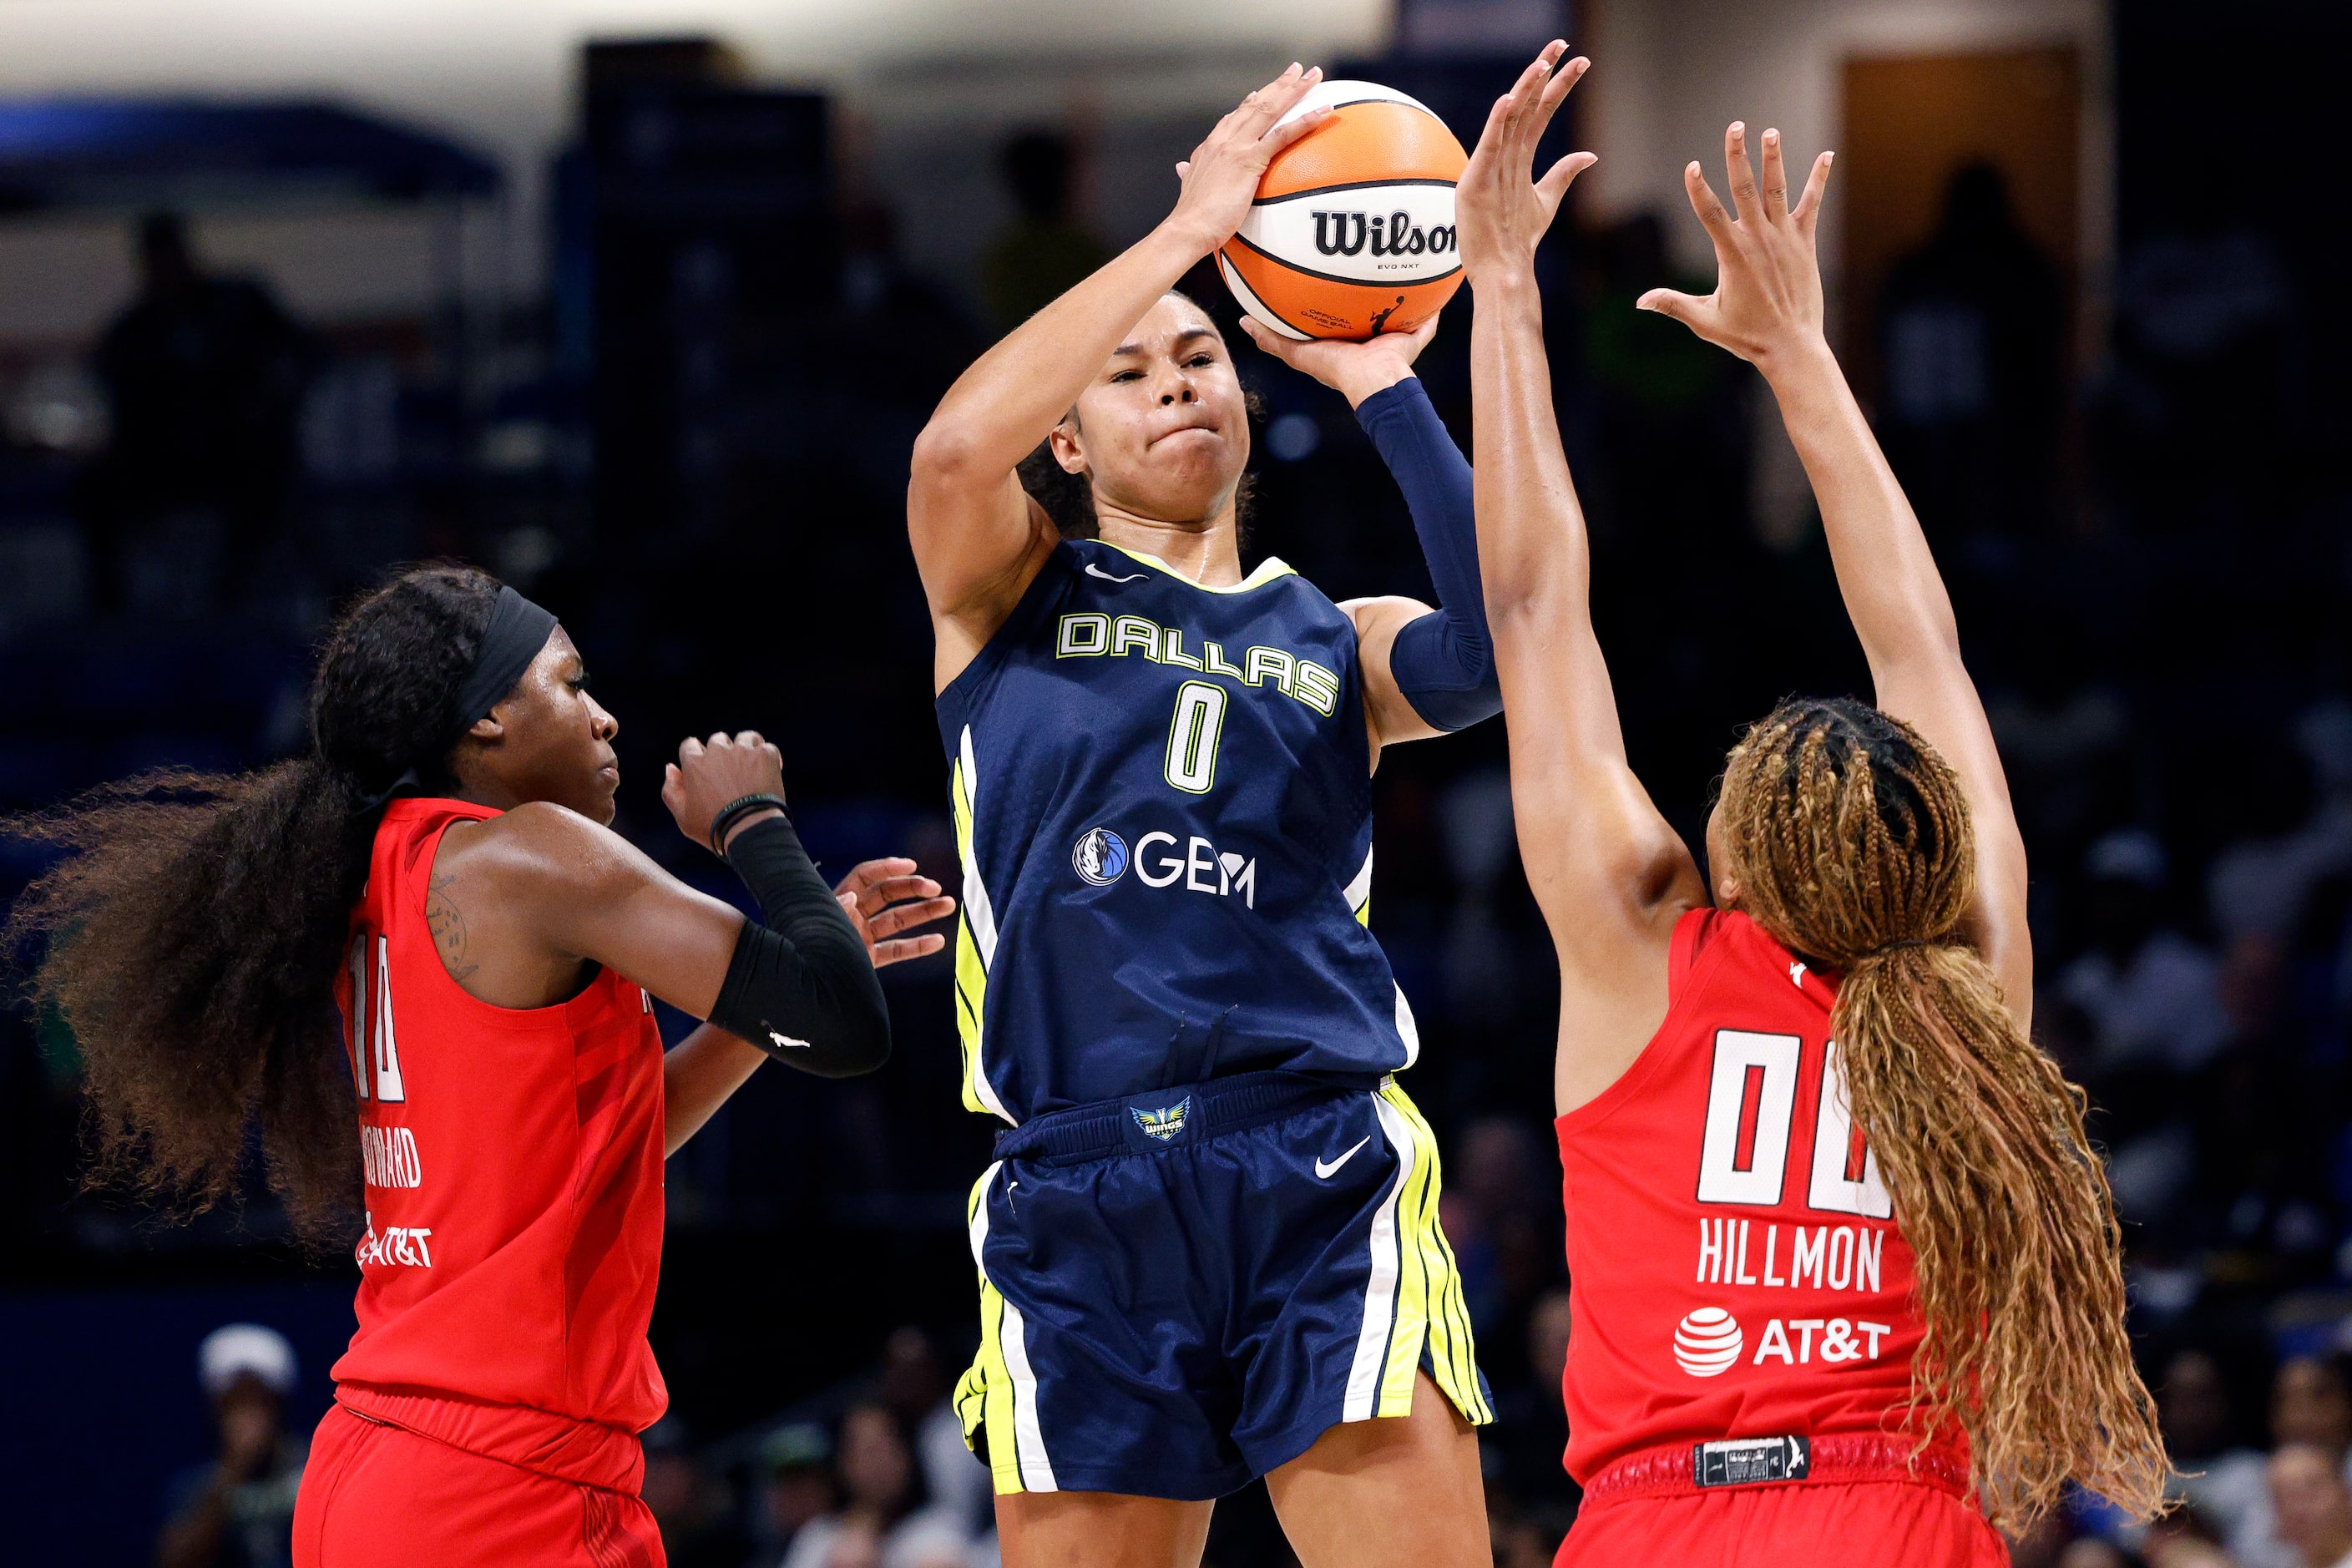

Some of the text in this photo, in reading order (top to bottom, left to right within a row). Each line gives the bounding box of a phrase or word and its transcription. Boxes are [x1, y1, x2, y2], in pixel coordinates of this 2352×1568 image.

[1301, 311, 1329, 324] GAME
[1330, 321, 1353, 330] BALL
[1309, 308, 1350, 324] OFFICIAL
[1056, 612, 1339, 717] DALLAS
[1164, 680, 1227, 795] 0
[1134, 831, 1256, 910] GEM
[348, 933, 405, 1103] 10
[368, 1227, 432, 1267] AT&T
[1696, 1217, 1884, 1293] HILLMON
[1753, 1318, 1891, 1366] AT&T
